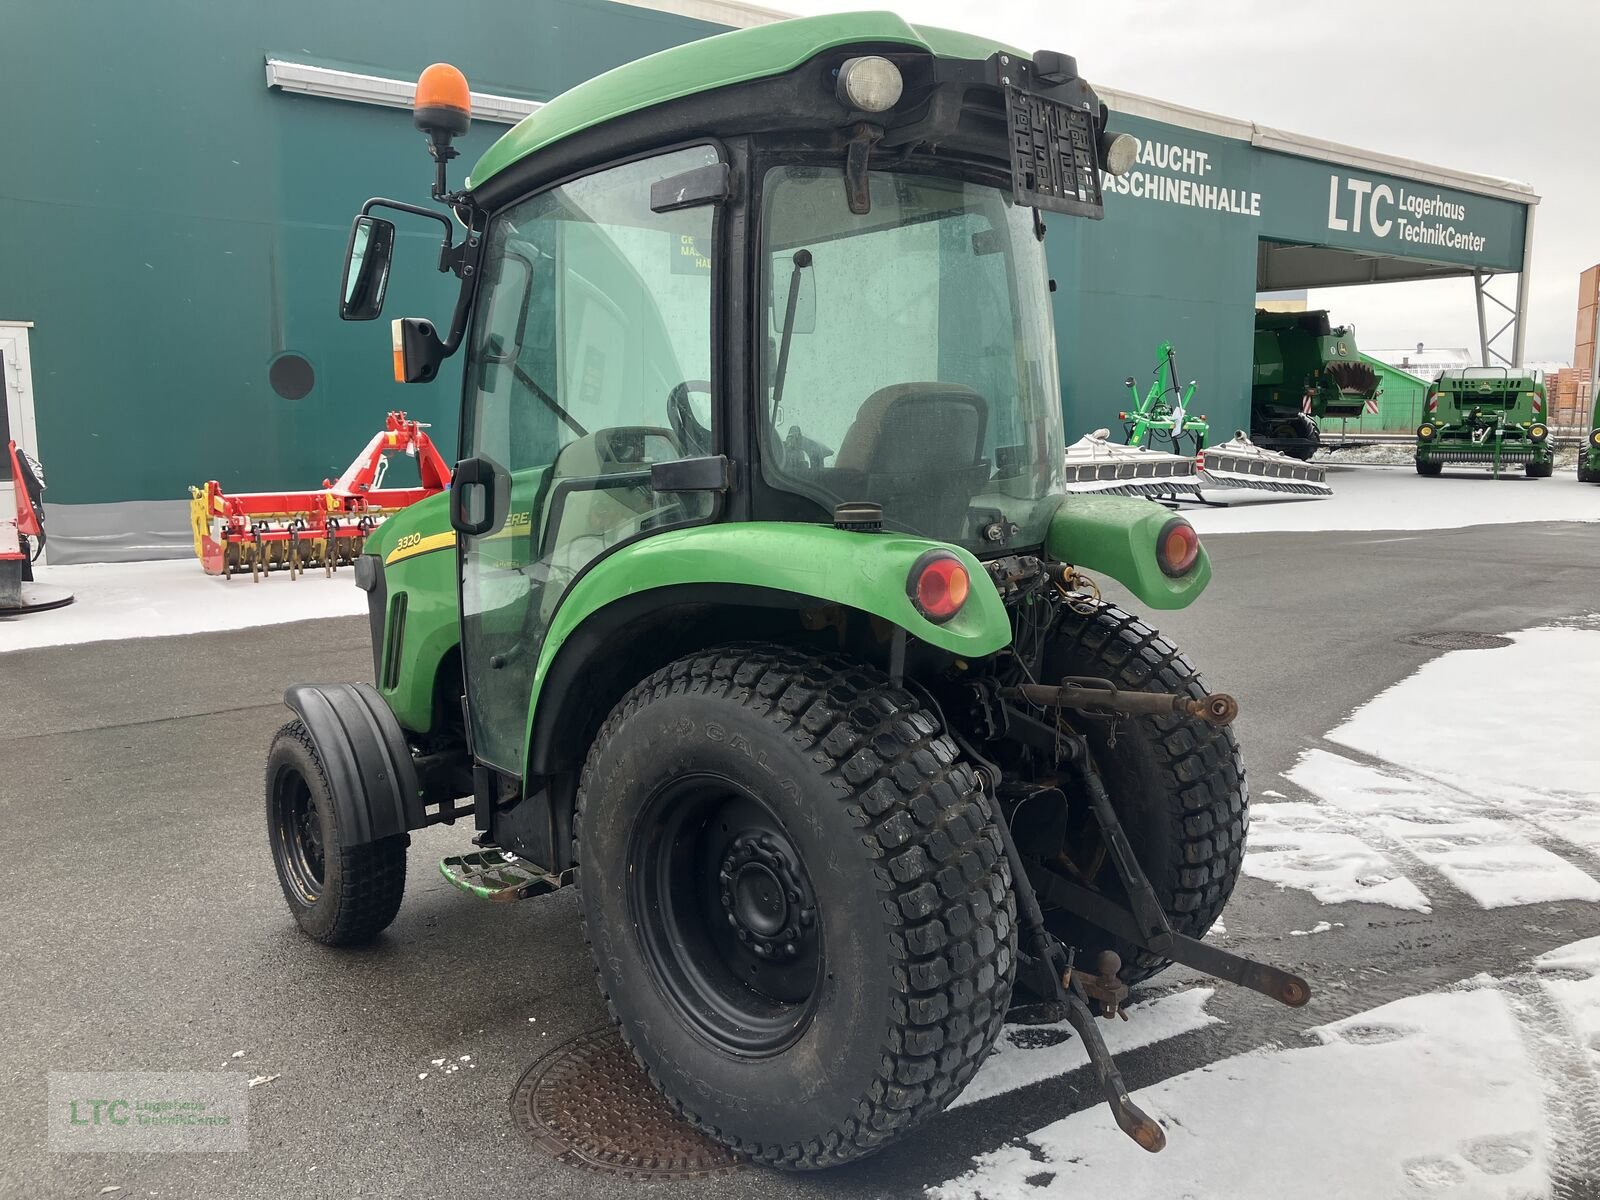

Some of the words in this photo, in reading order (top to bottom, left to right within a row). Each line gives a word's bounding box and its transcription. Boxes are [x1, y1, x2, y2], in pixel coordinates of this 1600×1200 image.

[1099, 169, 1261, 216] ASCHINENHALLE
[1328, 175, 1394, 238] LTC
[1399, 188, 1465, 221] Lagerhaus
[1397, 218, 1486, 252] TechnikCenter
[397, 532, 421, 551] 3320
